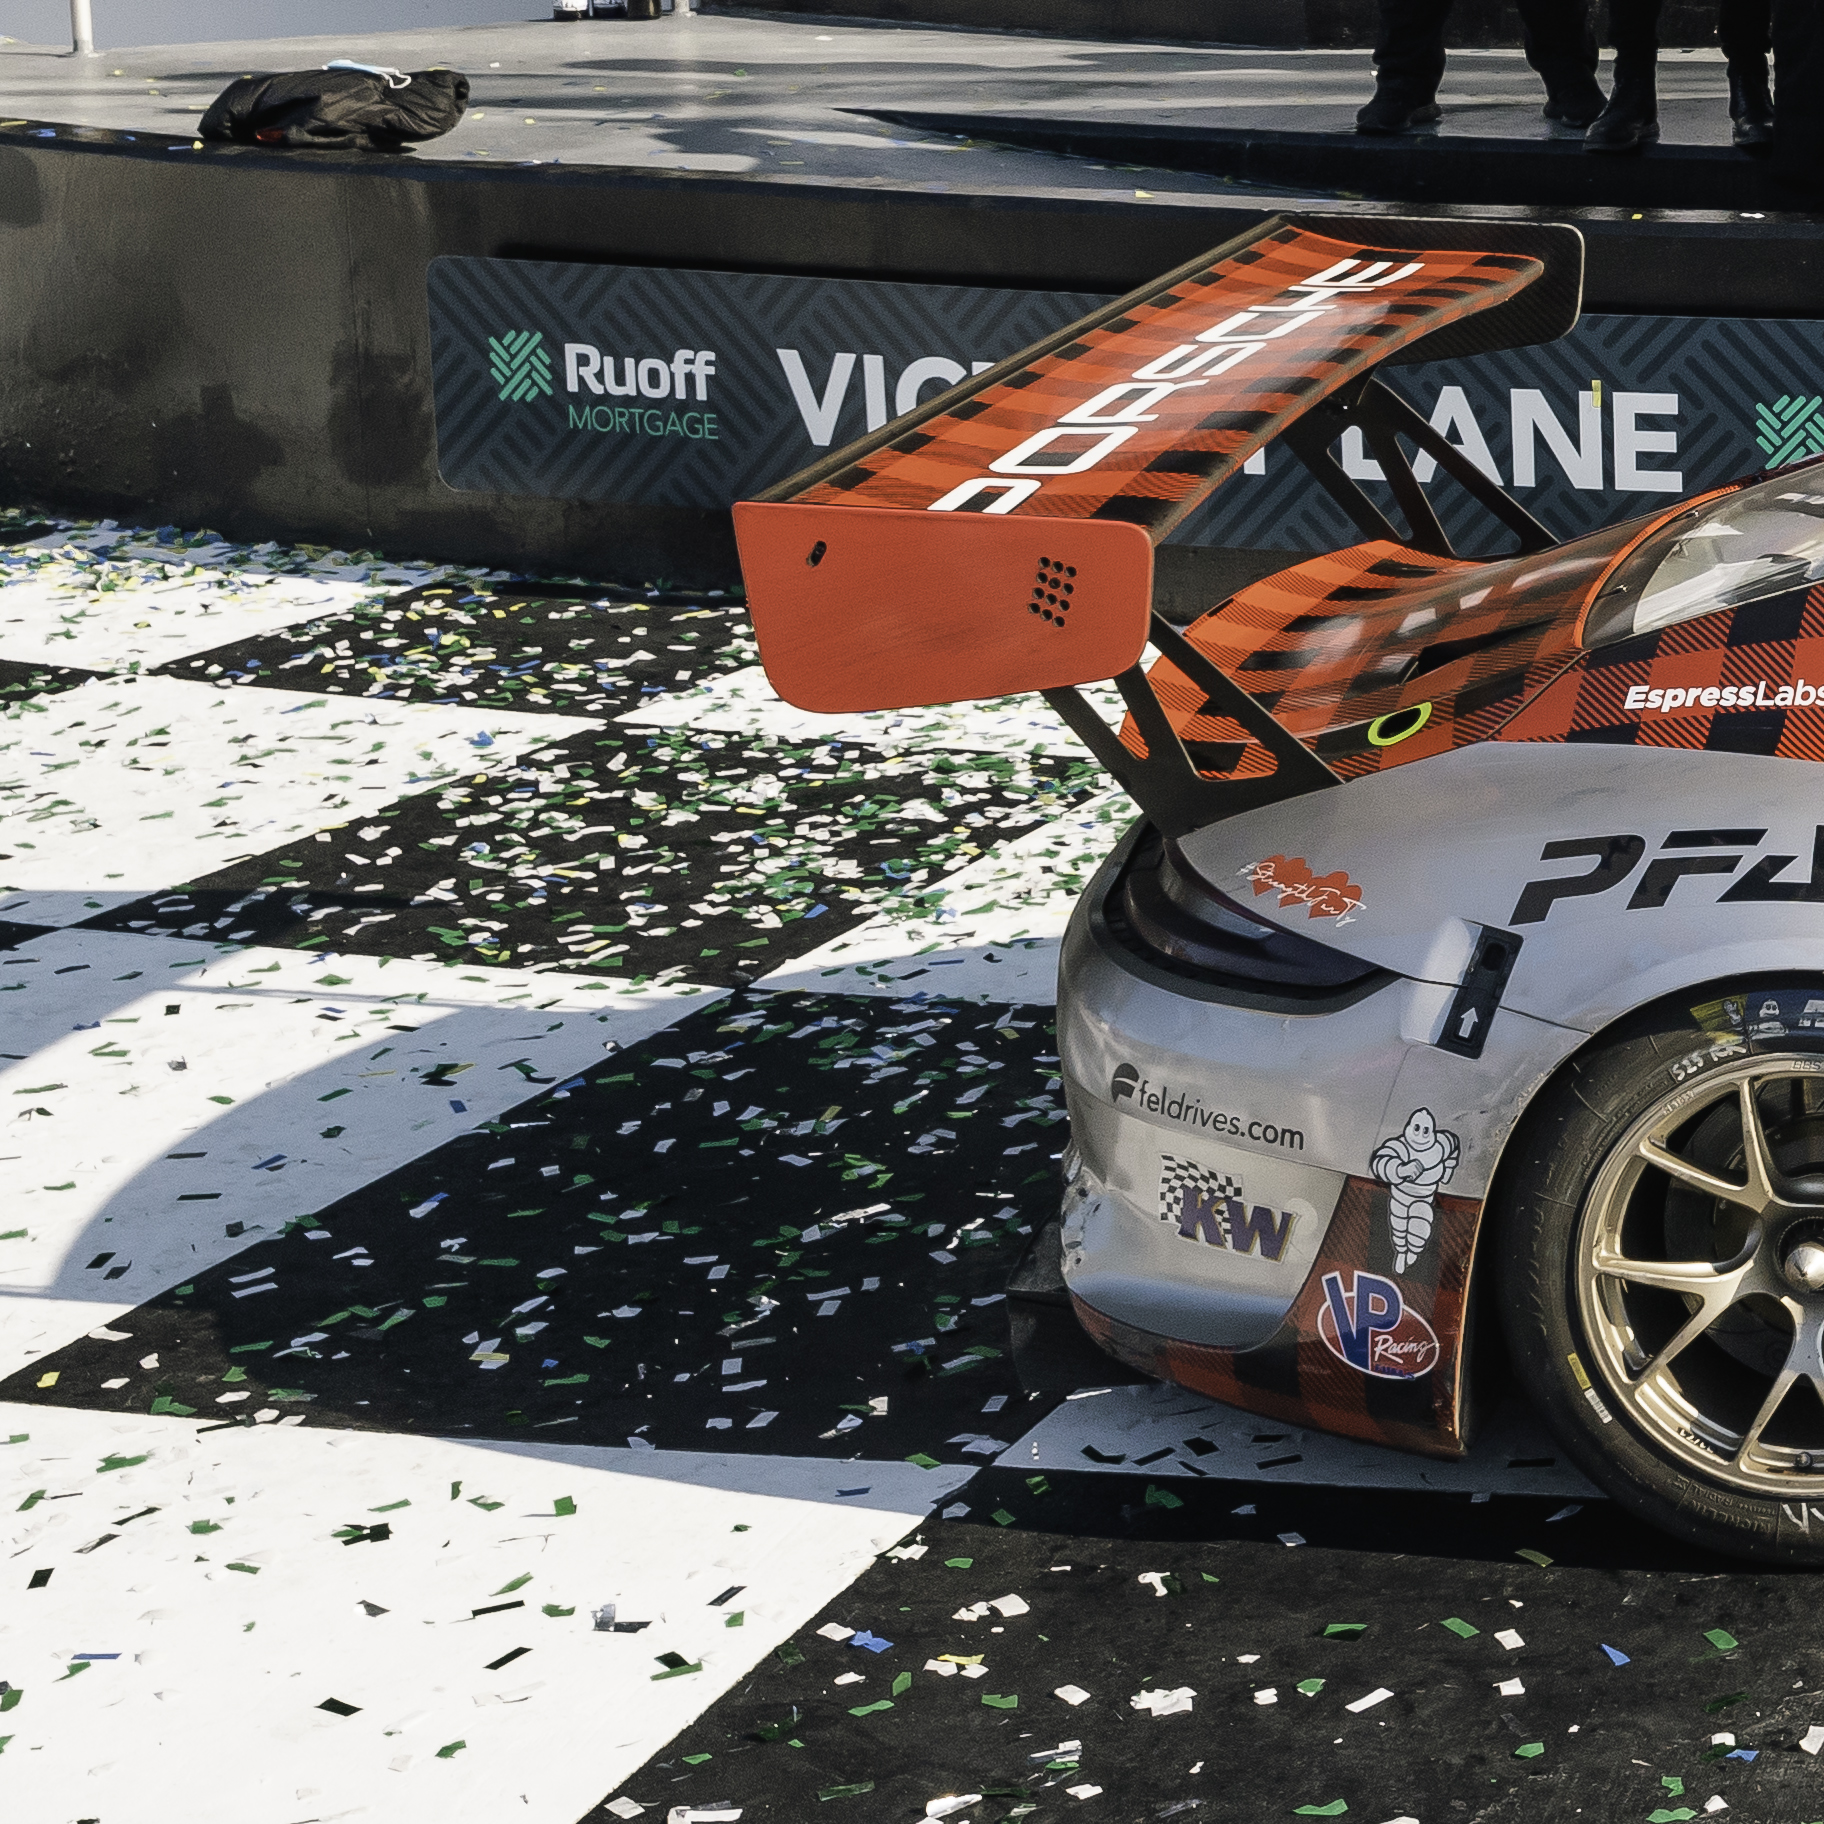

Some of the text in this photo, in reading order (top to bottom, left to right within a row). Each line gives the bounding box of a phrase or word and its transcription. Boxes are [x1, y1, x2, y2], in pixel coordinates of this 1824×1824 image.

[564, 343, 716, 401] Ruoff
[569, 404, 719, 440] MORTGAGE
[1138, 1079, 1305, 1151] feldrives.com
[1177, 1184, 1297, 1262] KW
[1322, 1270, 1403, 1372] VP
[1373, 1334, 1438, 1364] Racing
